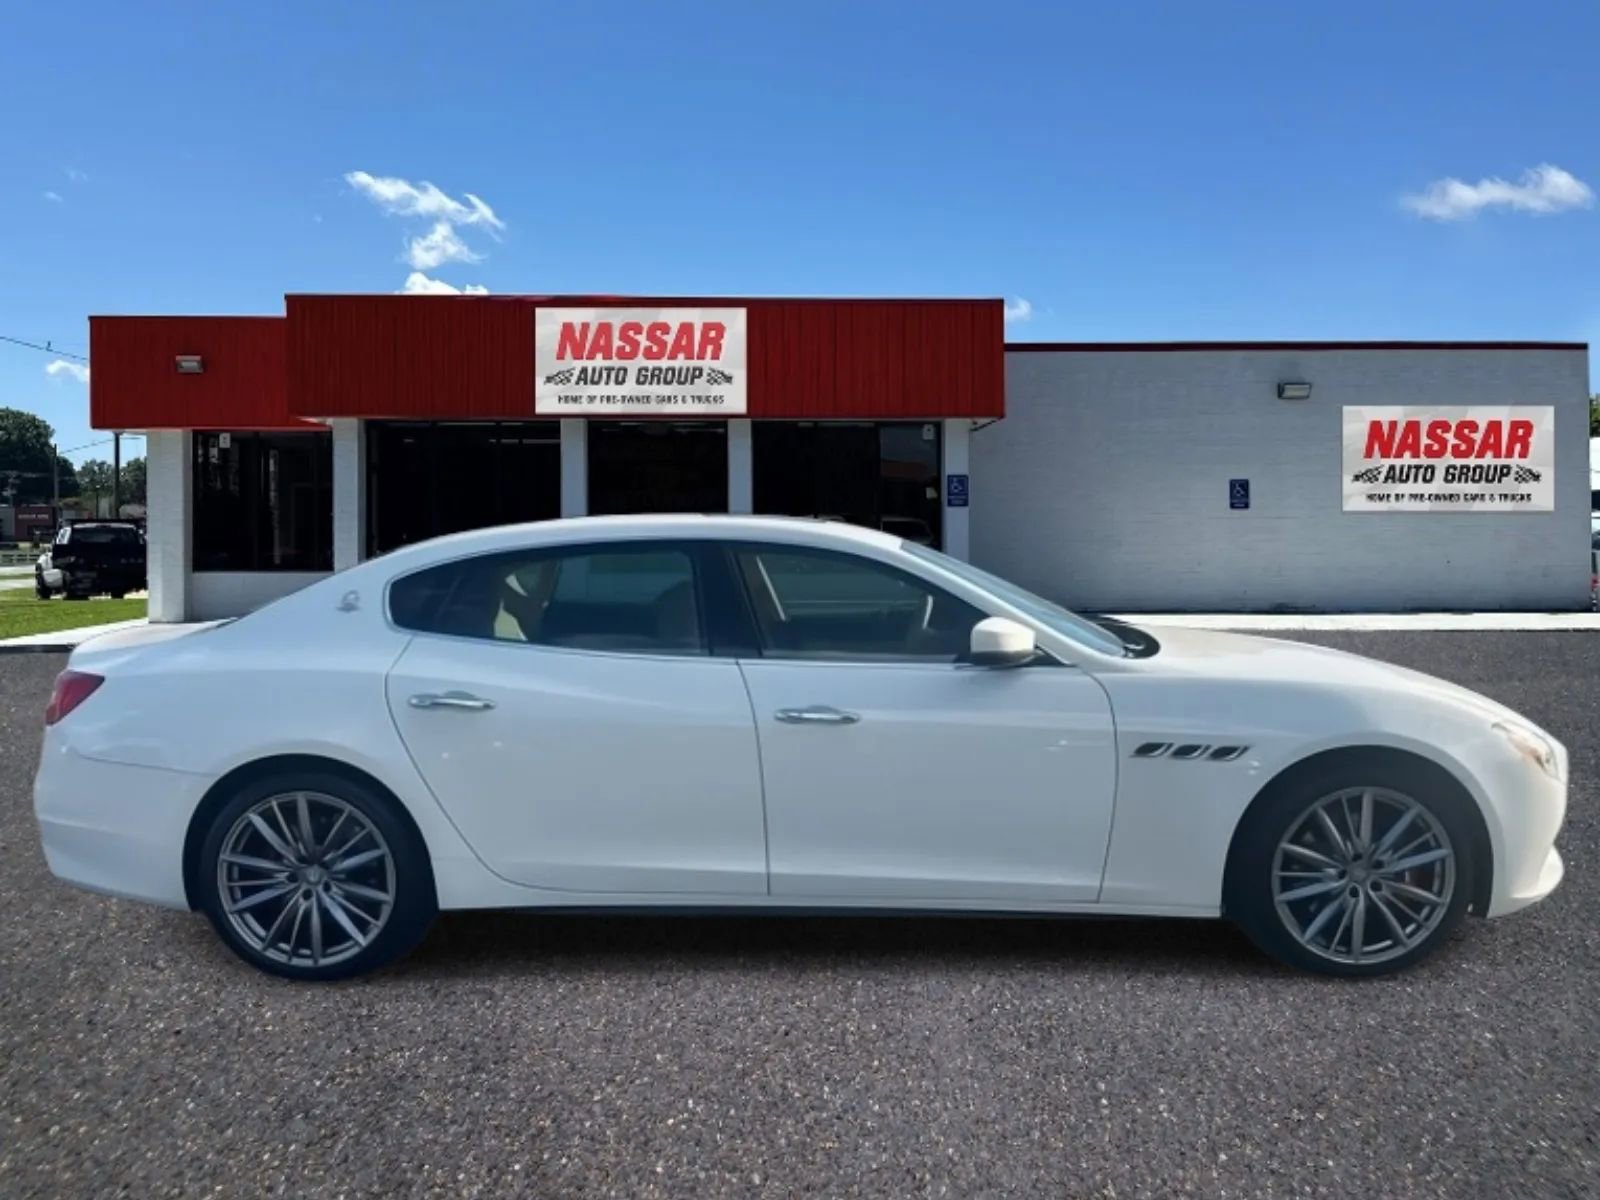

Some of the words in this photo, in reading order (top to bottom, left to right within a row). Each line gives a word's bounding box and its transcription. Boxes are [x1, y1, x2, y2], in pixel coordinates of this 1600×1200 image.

[556, 321, 726, 361] NASSAR
[575, 366, 628, 386] AUTO
[635, 366, 703, 386] GROUP
[558, 395, 582, 405] HOME
[586, 395, 597, 405] OF
[1363, 419, 1534, 459] NASSAR
[1383, 464, 1435, 484] AUTO
[1443, 464, 1512, 484] GROUP
[1366, 493, 1391, 503] HOME
[1394, 493, 1405, 503] OF
